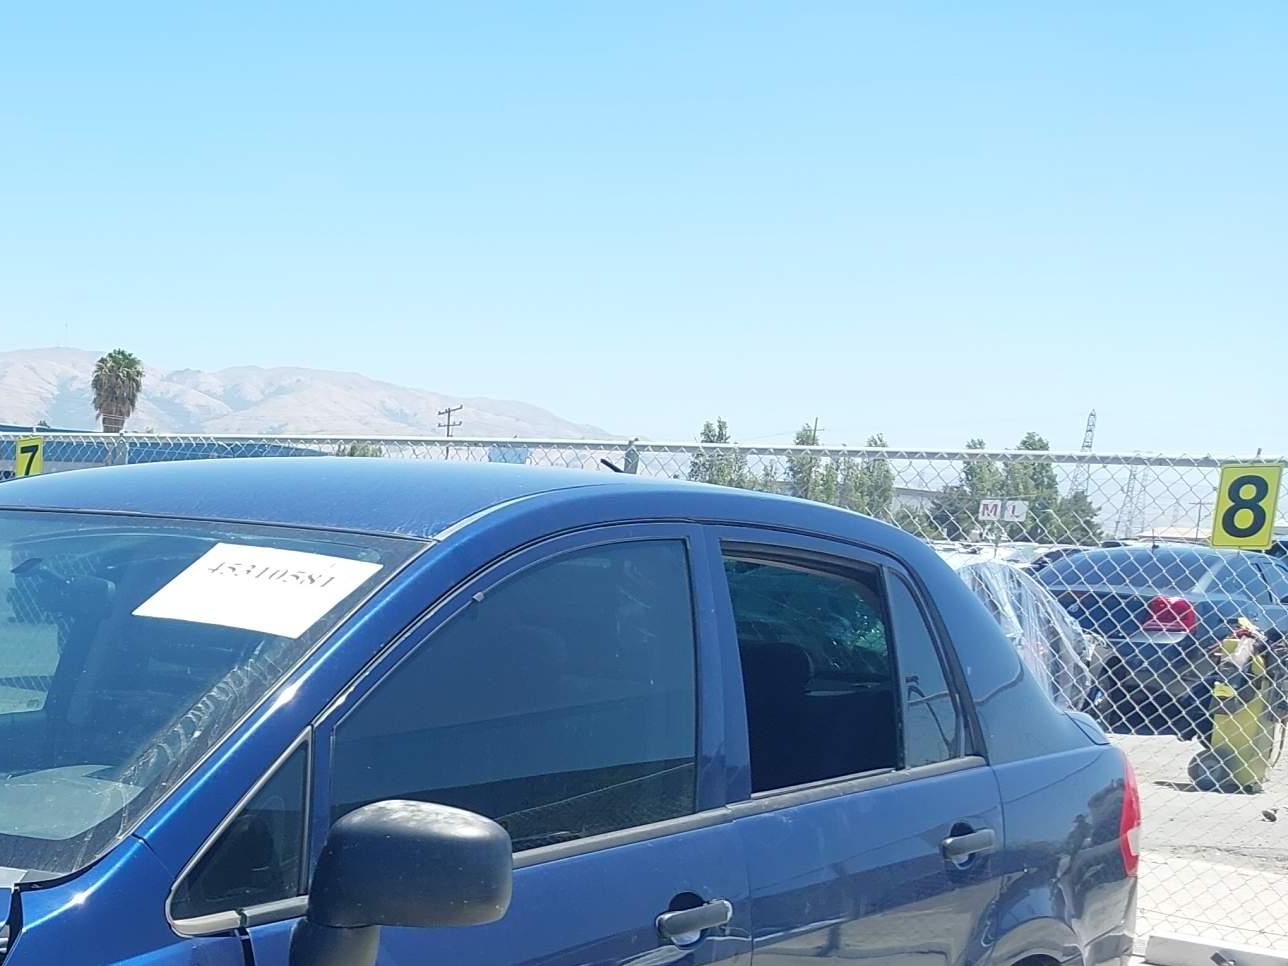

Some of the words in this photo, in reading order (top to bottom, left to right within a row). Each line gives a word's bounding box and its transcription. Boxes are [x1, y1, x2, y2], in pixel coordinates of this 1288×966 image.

[20, 444, 40, 476] 7
[981, 503, 999, 516] M
[1221, 474, 1269, 538] 8
[207, 561, 336, 588] 45310581
